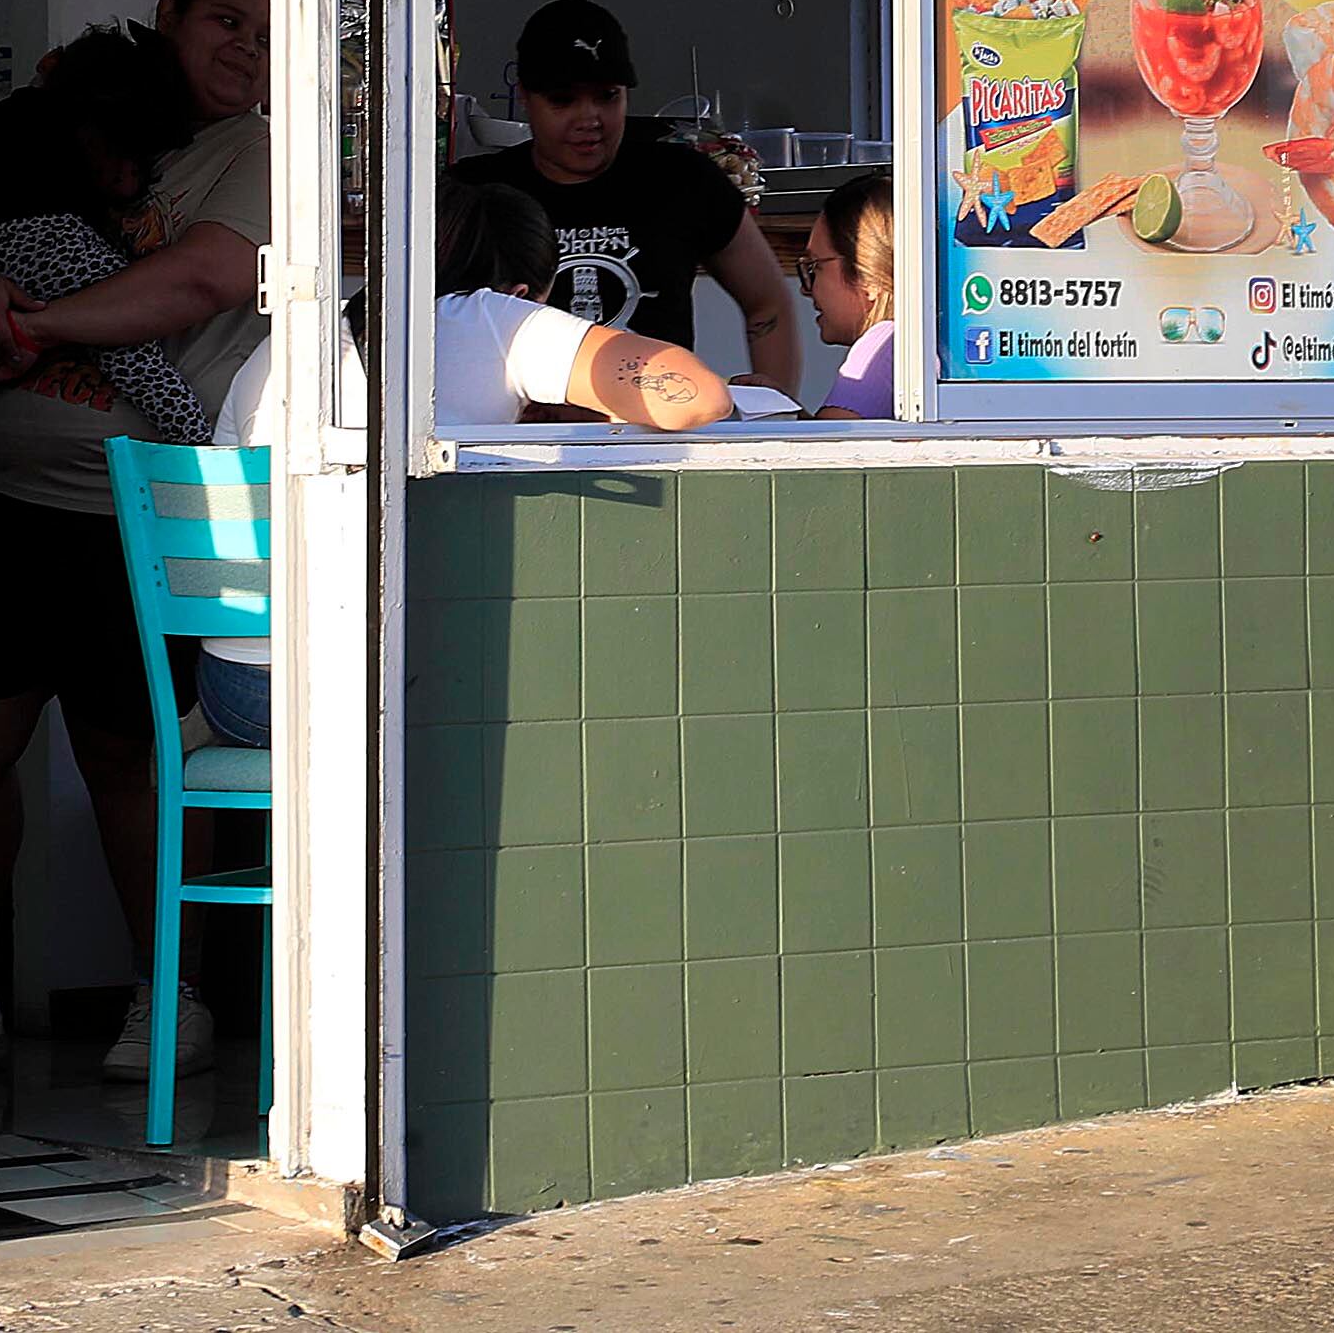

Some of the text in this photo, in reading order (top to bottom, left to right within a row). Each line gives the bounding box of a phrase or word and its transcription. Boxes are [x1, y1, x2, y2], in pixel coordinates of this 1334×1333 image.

[971, 75, 1066, 126] PICARITAS
[1000, 279, 1122, 307] 8813-5757
[1282, 283, 1295, 308] El
[999, 331, 1013, 357] El
[1018, 330, 1063, 357] timón
[1068, 331, 1090, 358] del
[1095, 331, 1137, 358] fortín
